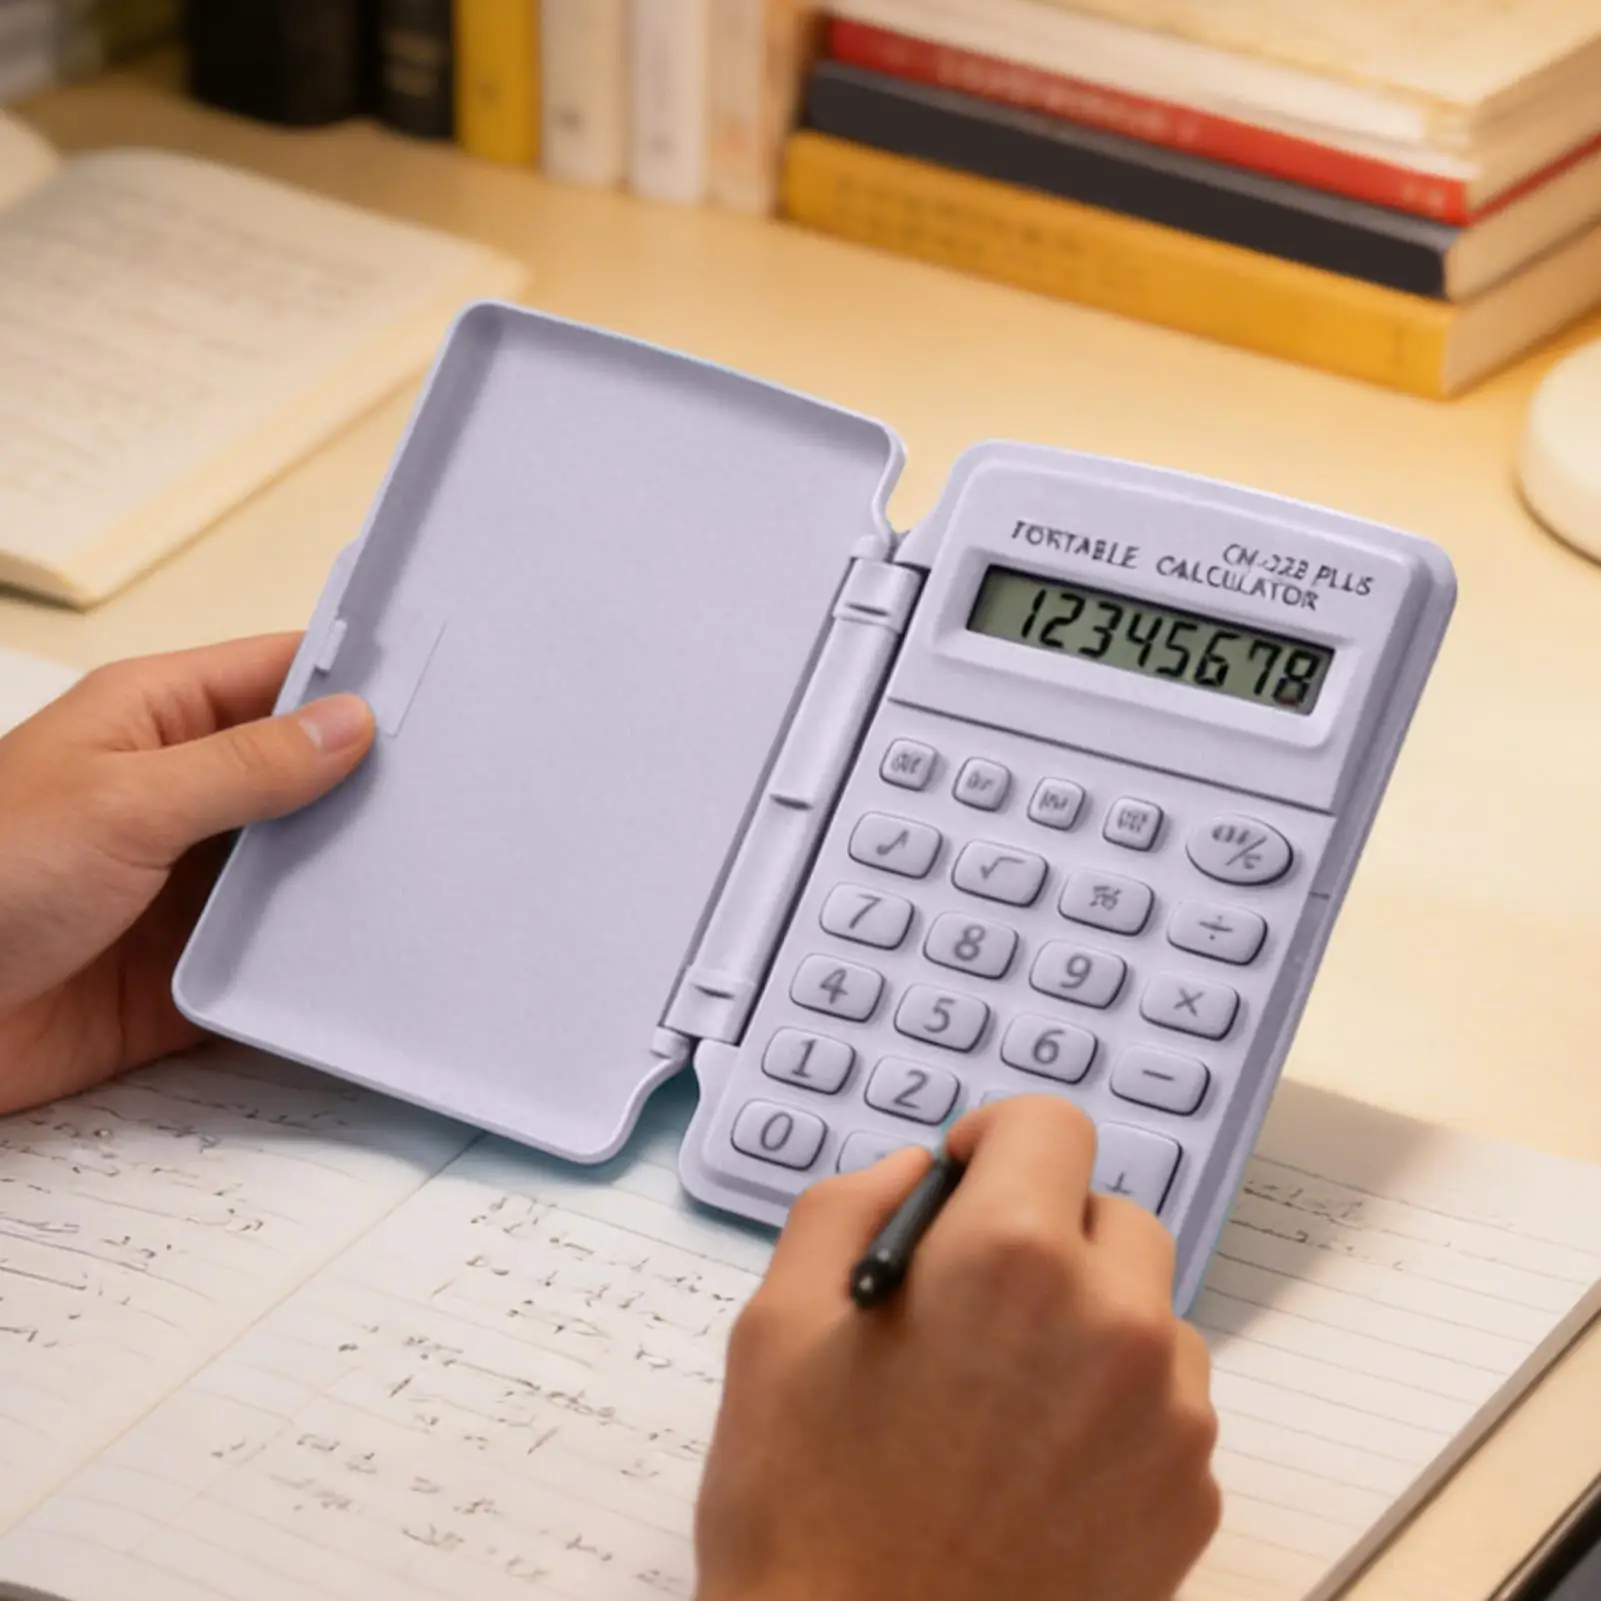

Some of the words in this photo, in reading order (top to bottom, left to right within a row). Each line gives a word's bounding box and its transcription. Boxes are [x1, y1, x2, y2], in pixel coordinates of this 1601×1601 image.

[1019, 588, 1321, 706] 12345678
[847, 894, 882, 931] 7
[952, 926, 986, 963] 8
[819, 968, 849, 1005] 4
[1059, 954, 1093, 990] 9
[923, 997, 955, 1034] 5
[790, 1039, 817, 1079] 1
[1032, 1029, 1065, 1066] 6
[892, 1069, 929, 1110] 2
[759, 1112, 794, 1153] 0
